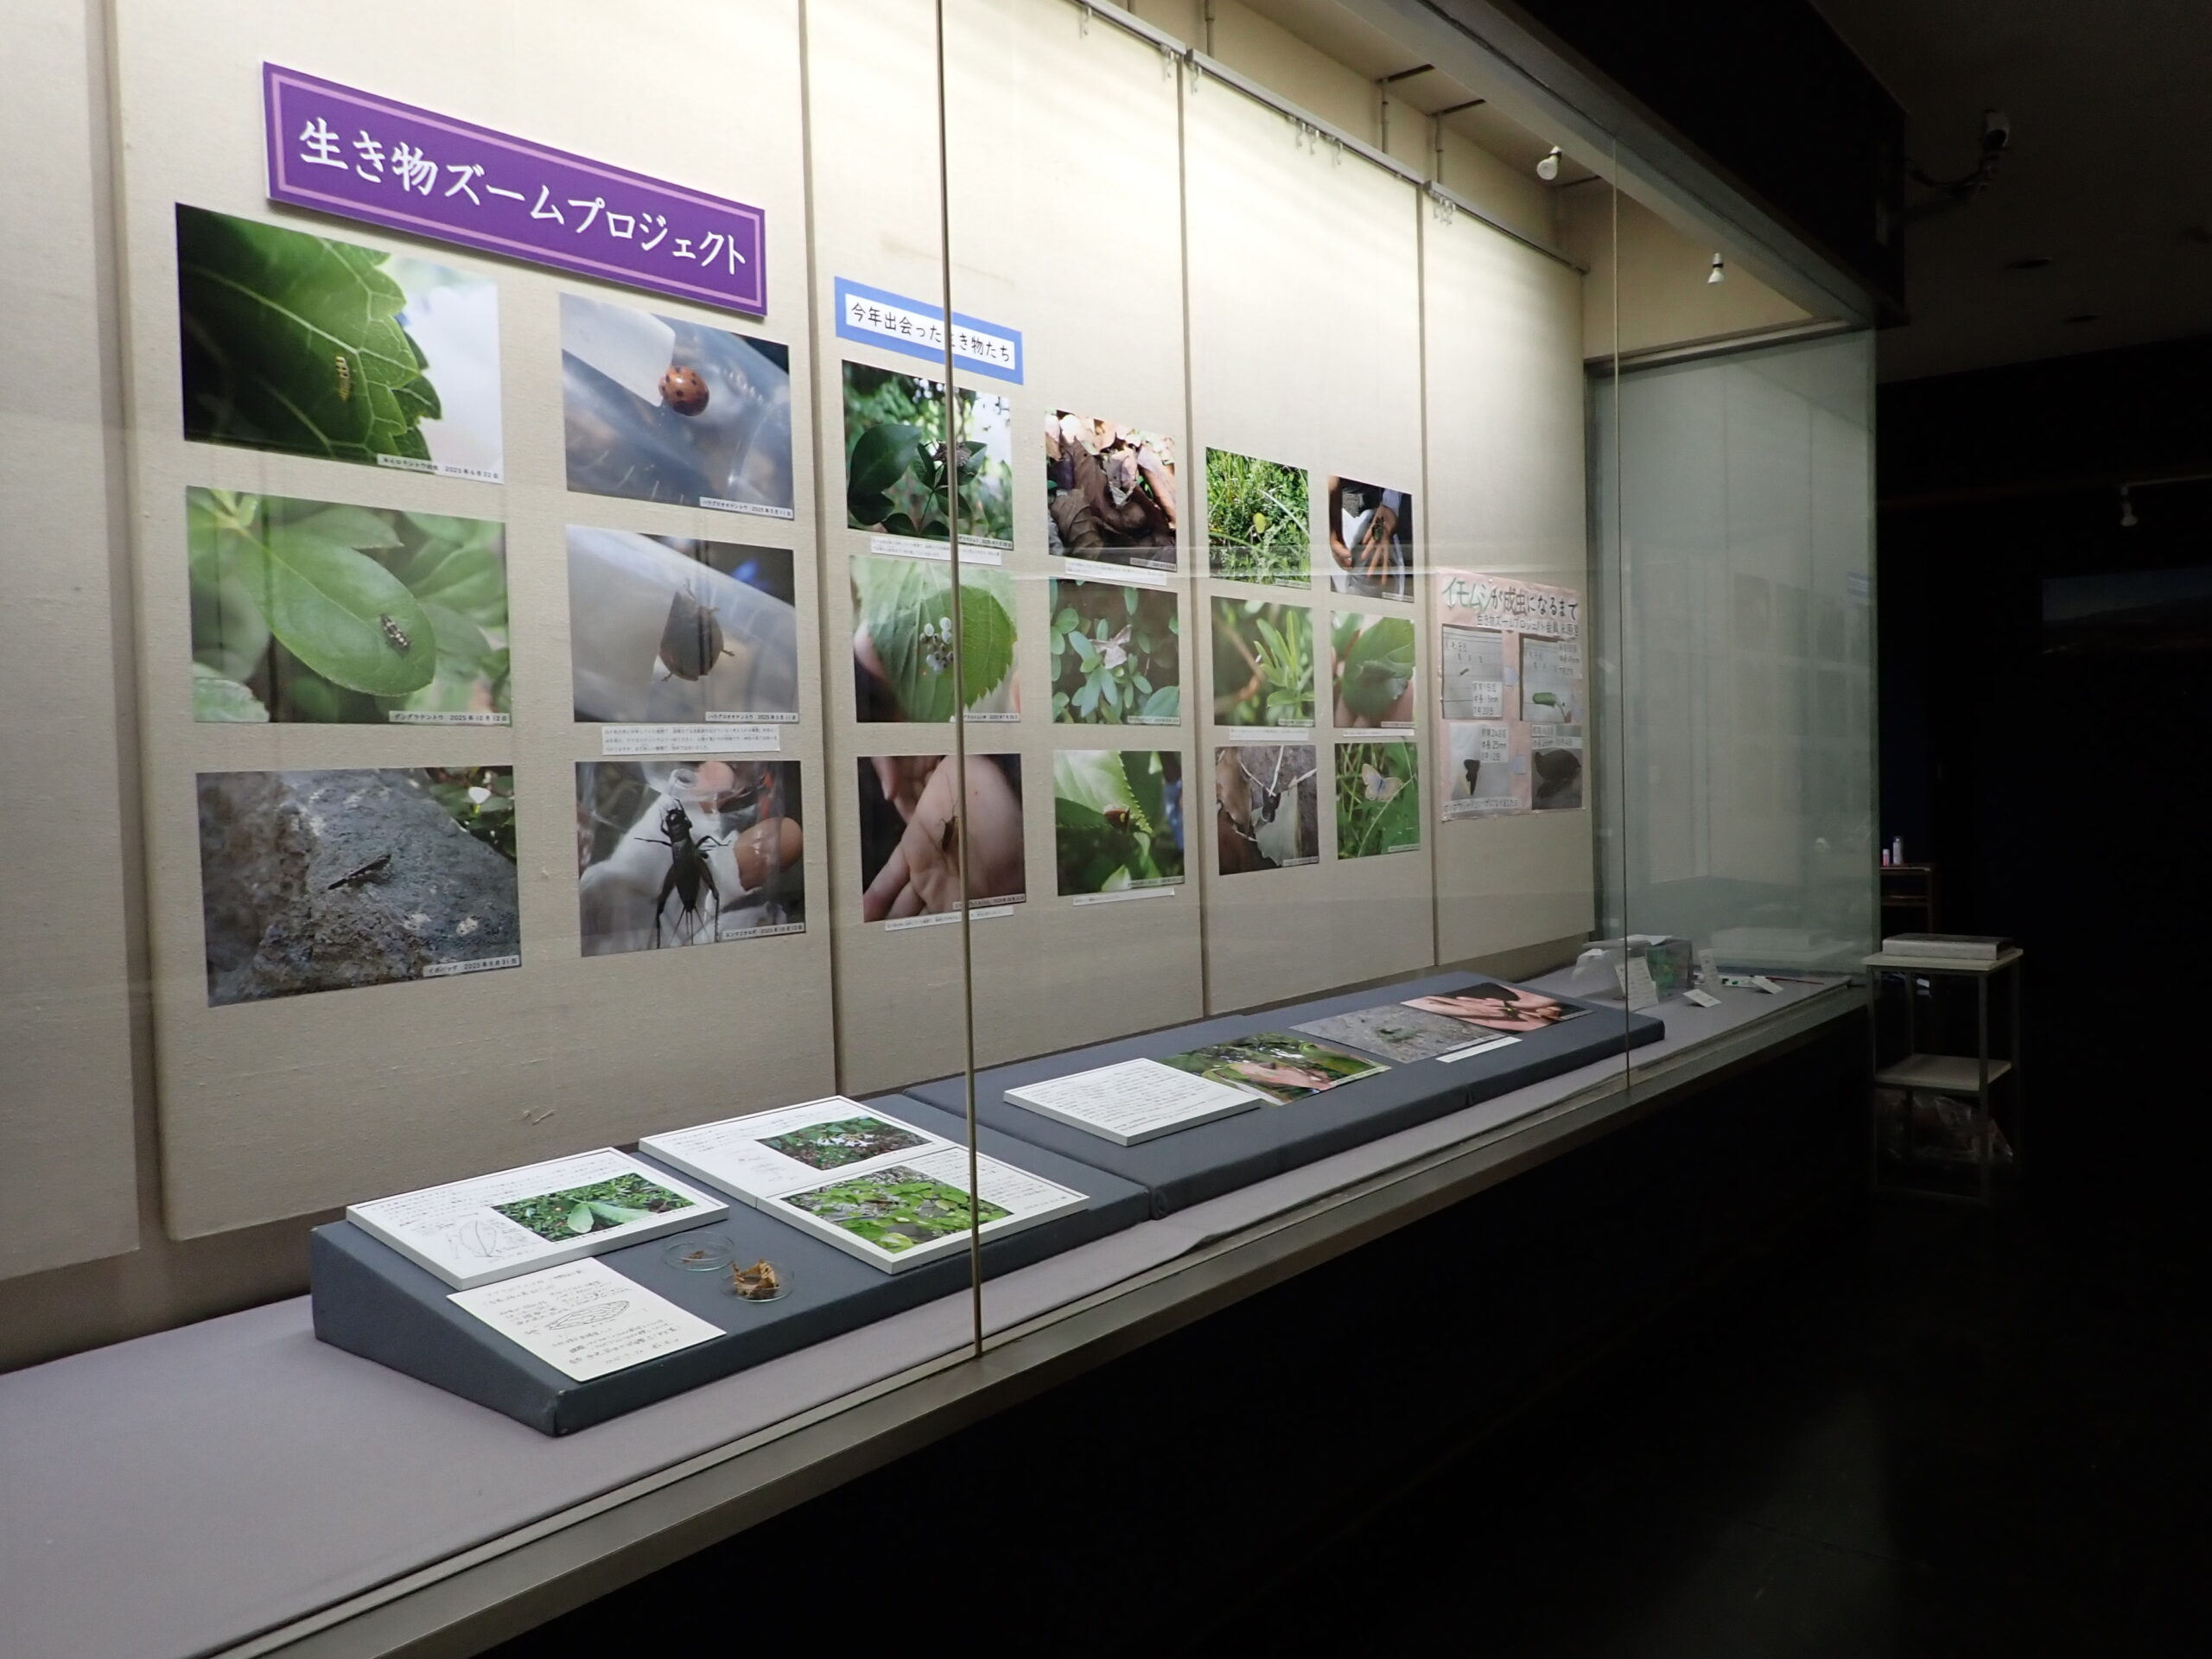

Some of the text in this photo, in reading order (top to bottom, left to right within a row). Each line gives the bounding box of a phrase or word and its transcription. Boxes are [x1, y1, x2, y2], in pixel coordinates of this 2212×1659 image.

[299, 118, 746, 275] 生き物ズームプロジェクト
